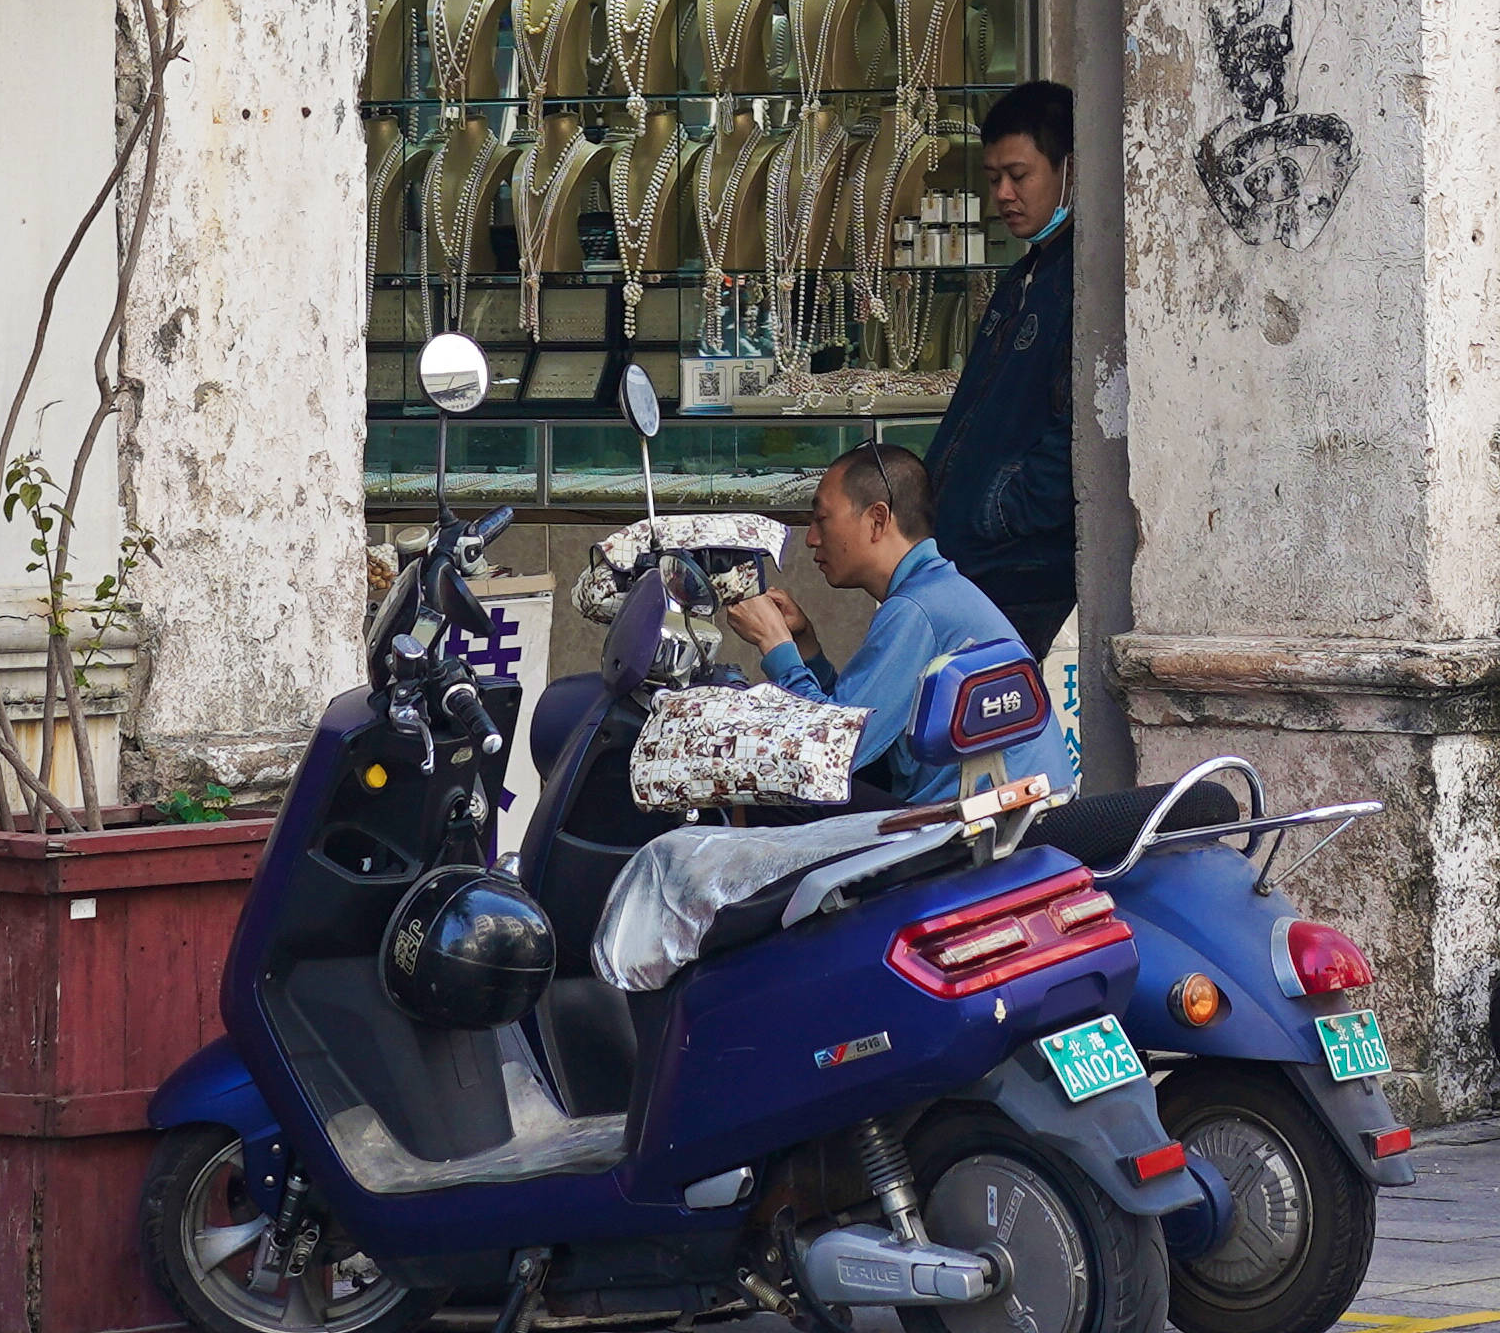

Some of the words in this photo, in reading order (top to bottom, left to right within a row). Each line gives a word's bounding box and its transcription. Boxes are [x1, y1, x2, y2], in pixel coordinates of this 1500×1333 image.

[982, 689, 1021, 719] 台铃
[1067, 1031, 1108, 1058] 北海
[1329, 1038, 1386, 1074] FZ103
[1062, 1044, 1138, 1094] AN025
